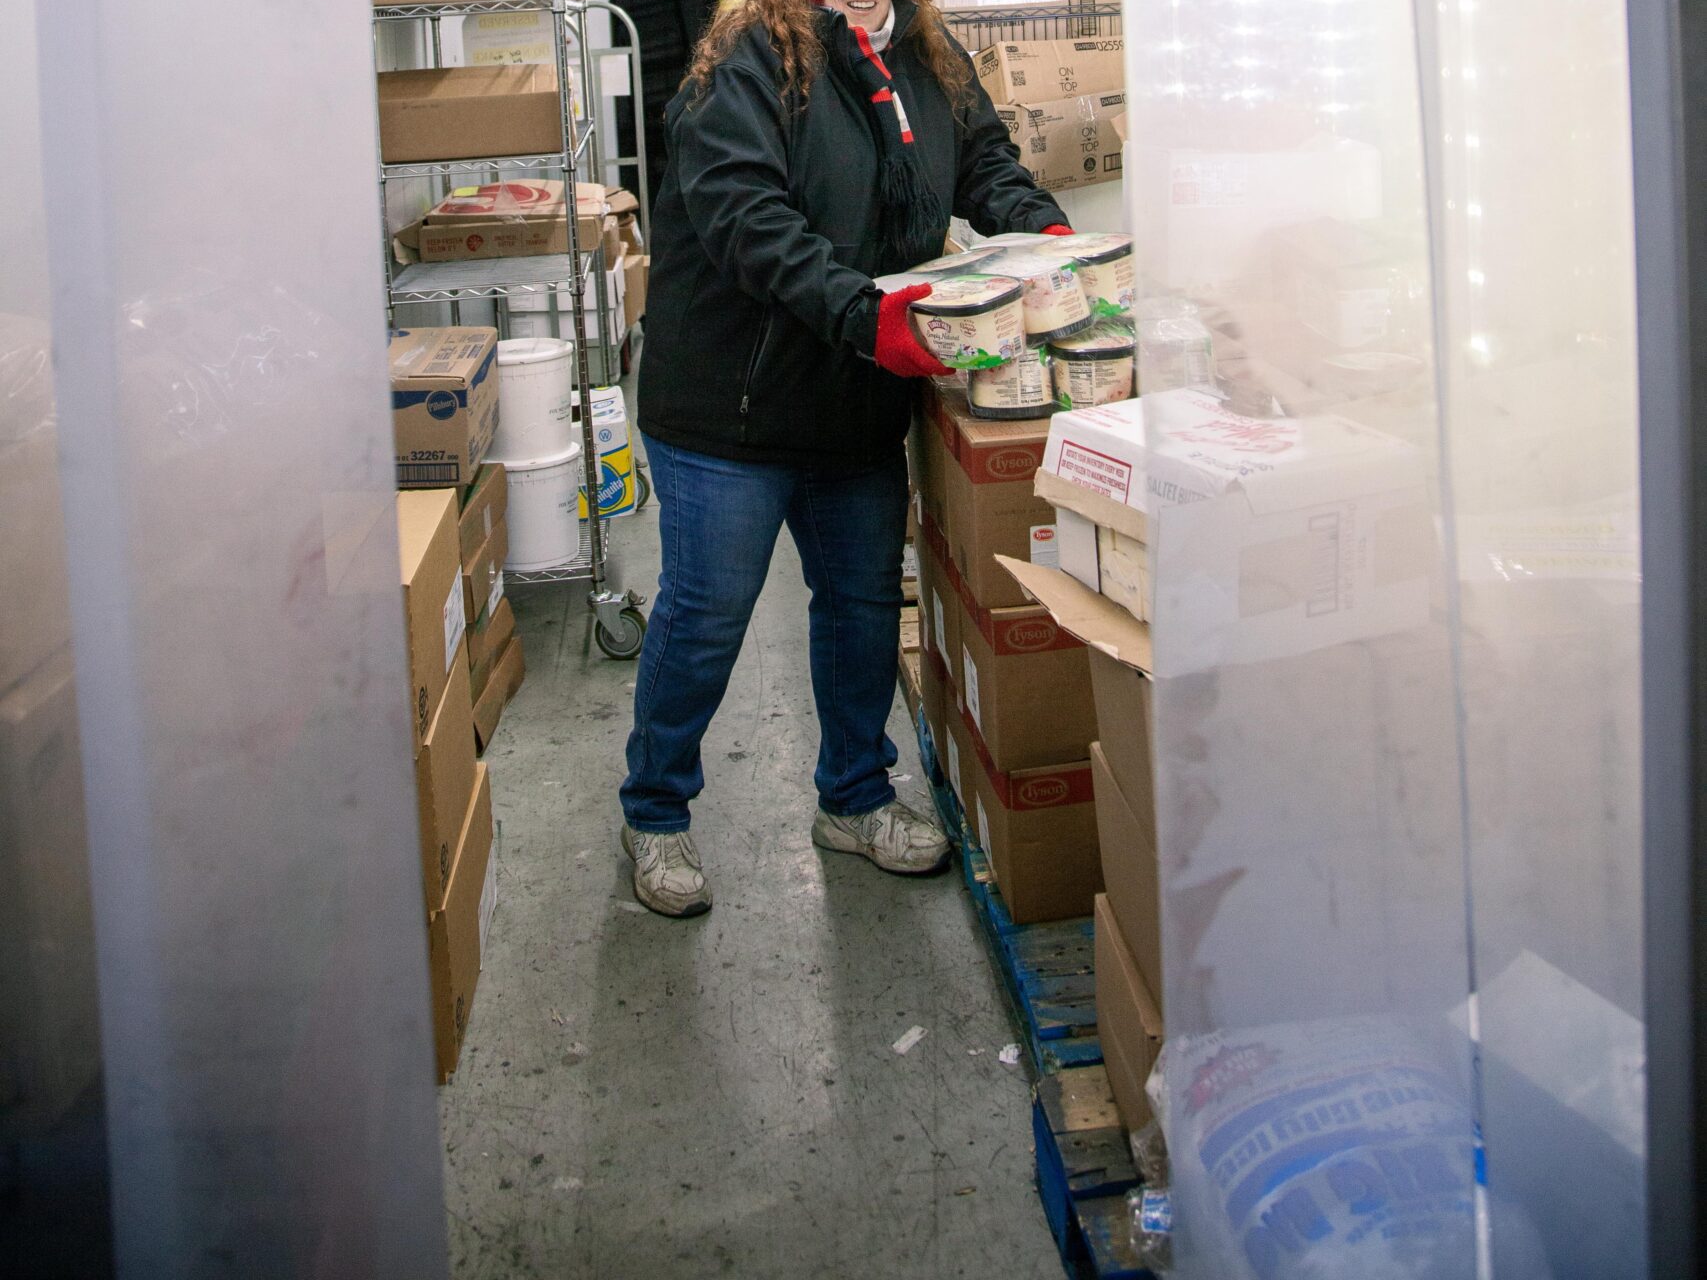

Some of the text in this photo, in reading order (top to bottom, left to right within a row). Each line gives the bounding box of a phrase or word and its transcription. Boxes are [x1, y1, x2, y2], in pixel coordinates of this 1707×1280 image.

[979, 58, 999, 79] 02559
[1058, 67, 1074, 77] ON
[1060, 81, 1078, 92] TOP
[1081, 126, 1097, 137] ON
[1080, 141, 1099, 153] TOP
[941, 332, 960, 341] Natural
[428, 399, 456, 413] Pillsbury
[410, 450, 446, 462] 32267
[995, 455, 1033, 473] Tyson
[1035, 531, 1053, 539] Tyson
[1013, 628, 1050, 645] Tyson
[1026, 784, 1065, 800] Tyson
